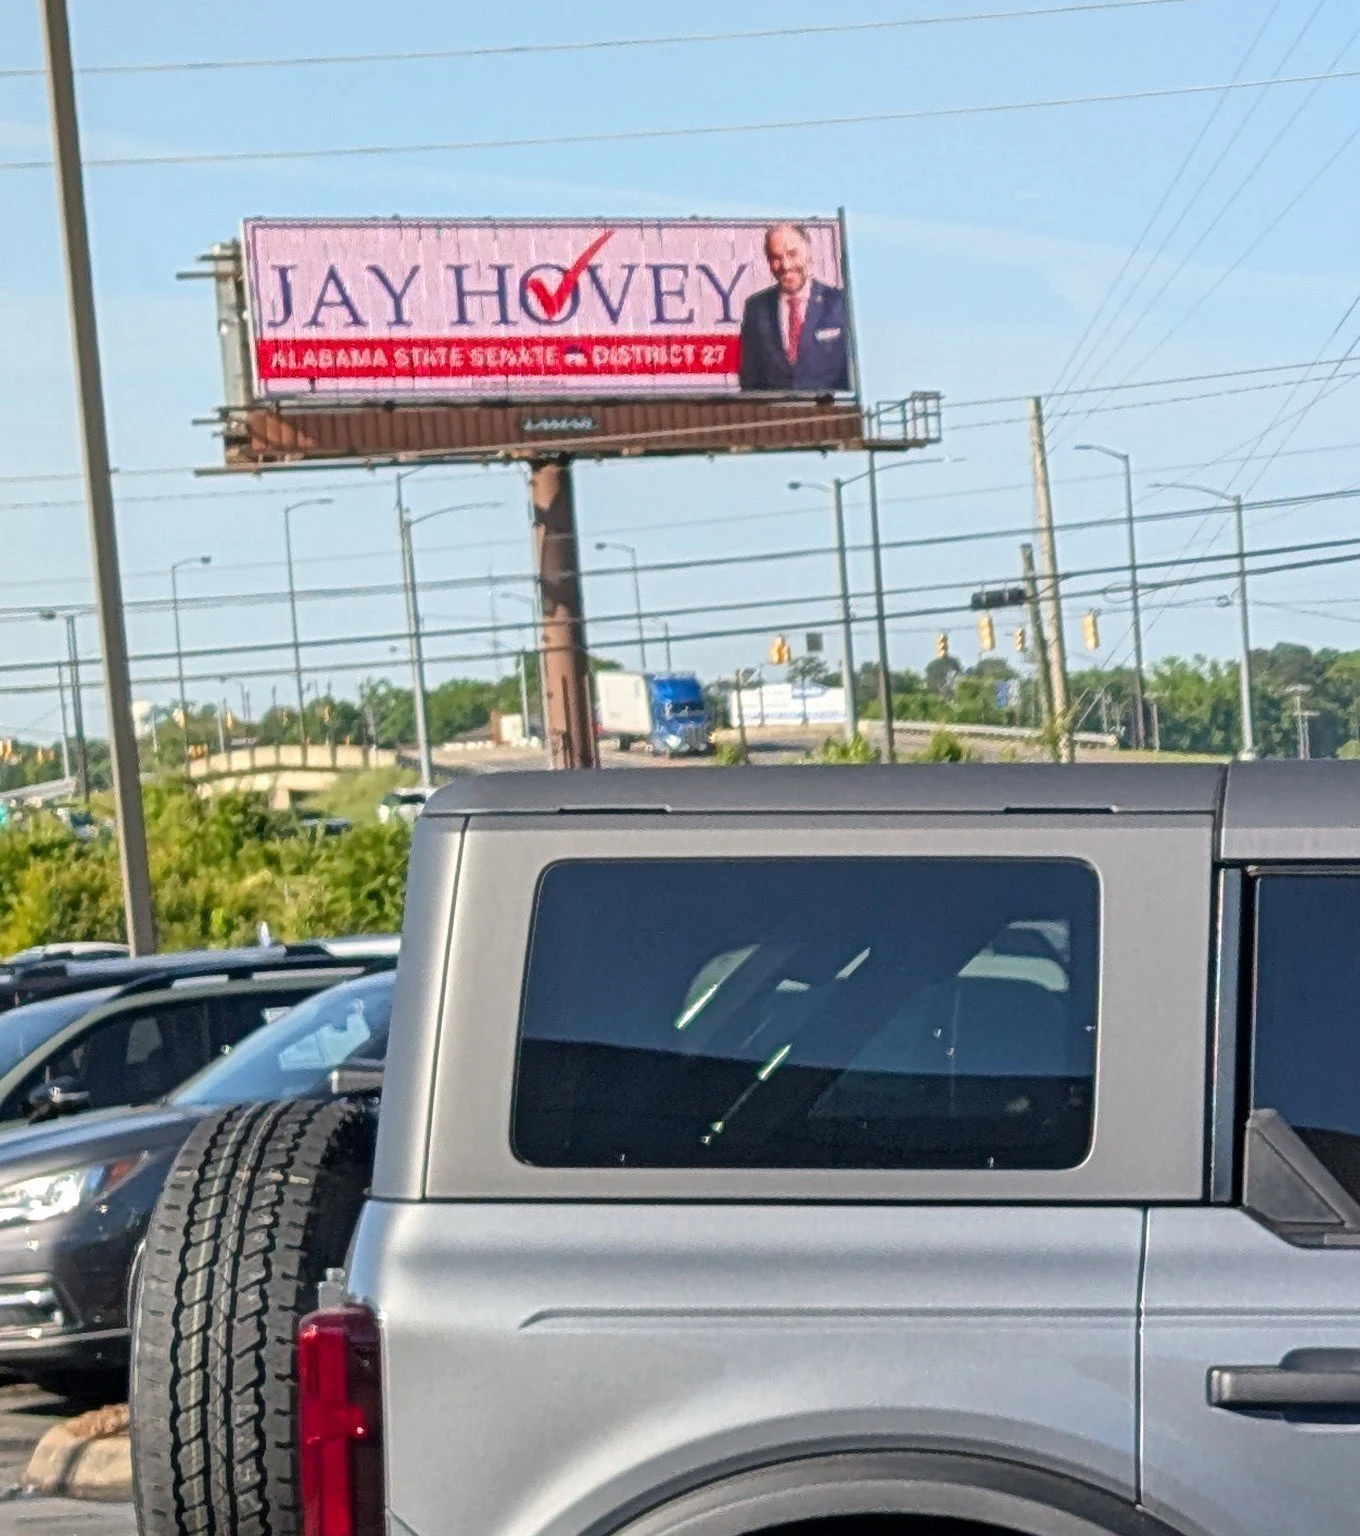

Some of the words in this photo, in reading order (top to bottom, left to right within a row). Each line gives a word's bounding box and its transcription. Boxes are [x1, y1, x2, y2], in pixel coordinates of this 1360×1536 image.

[268, 263, 420, 328] JAY
[446, 263, 748, 327] HOVEY
[270, 348, 388, 369] ALABAMA
[394, 347, 464, 368] STATE
[470, 346, 561, 367] SENATE
[593, 345, 697, 366] DISTRICT
[703, 344, 728, 365] 27
